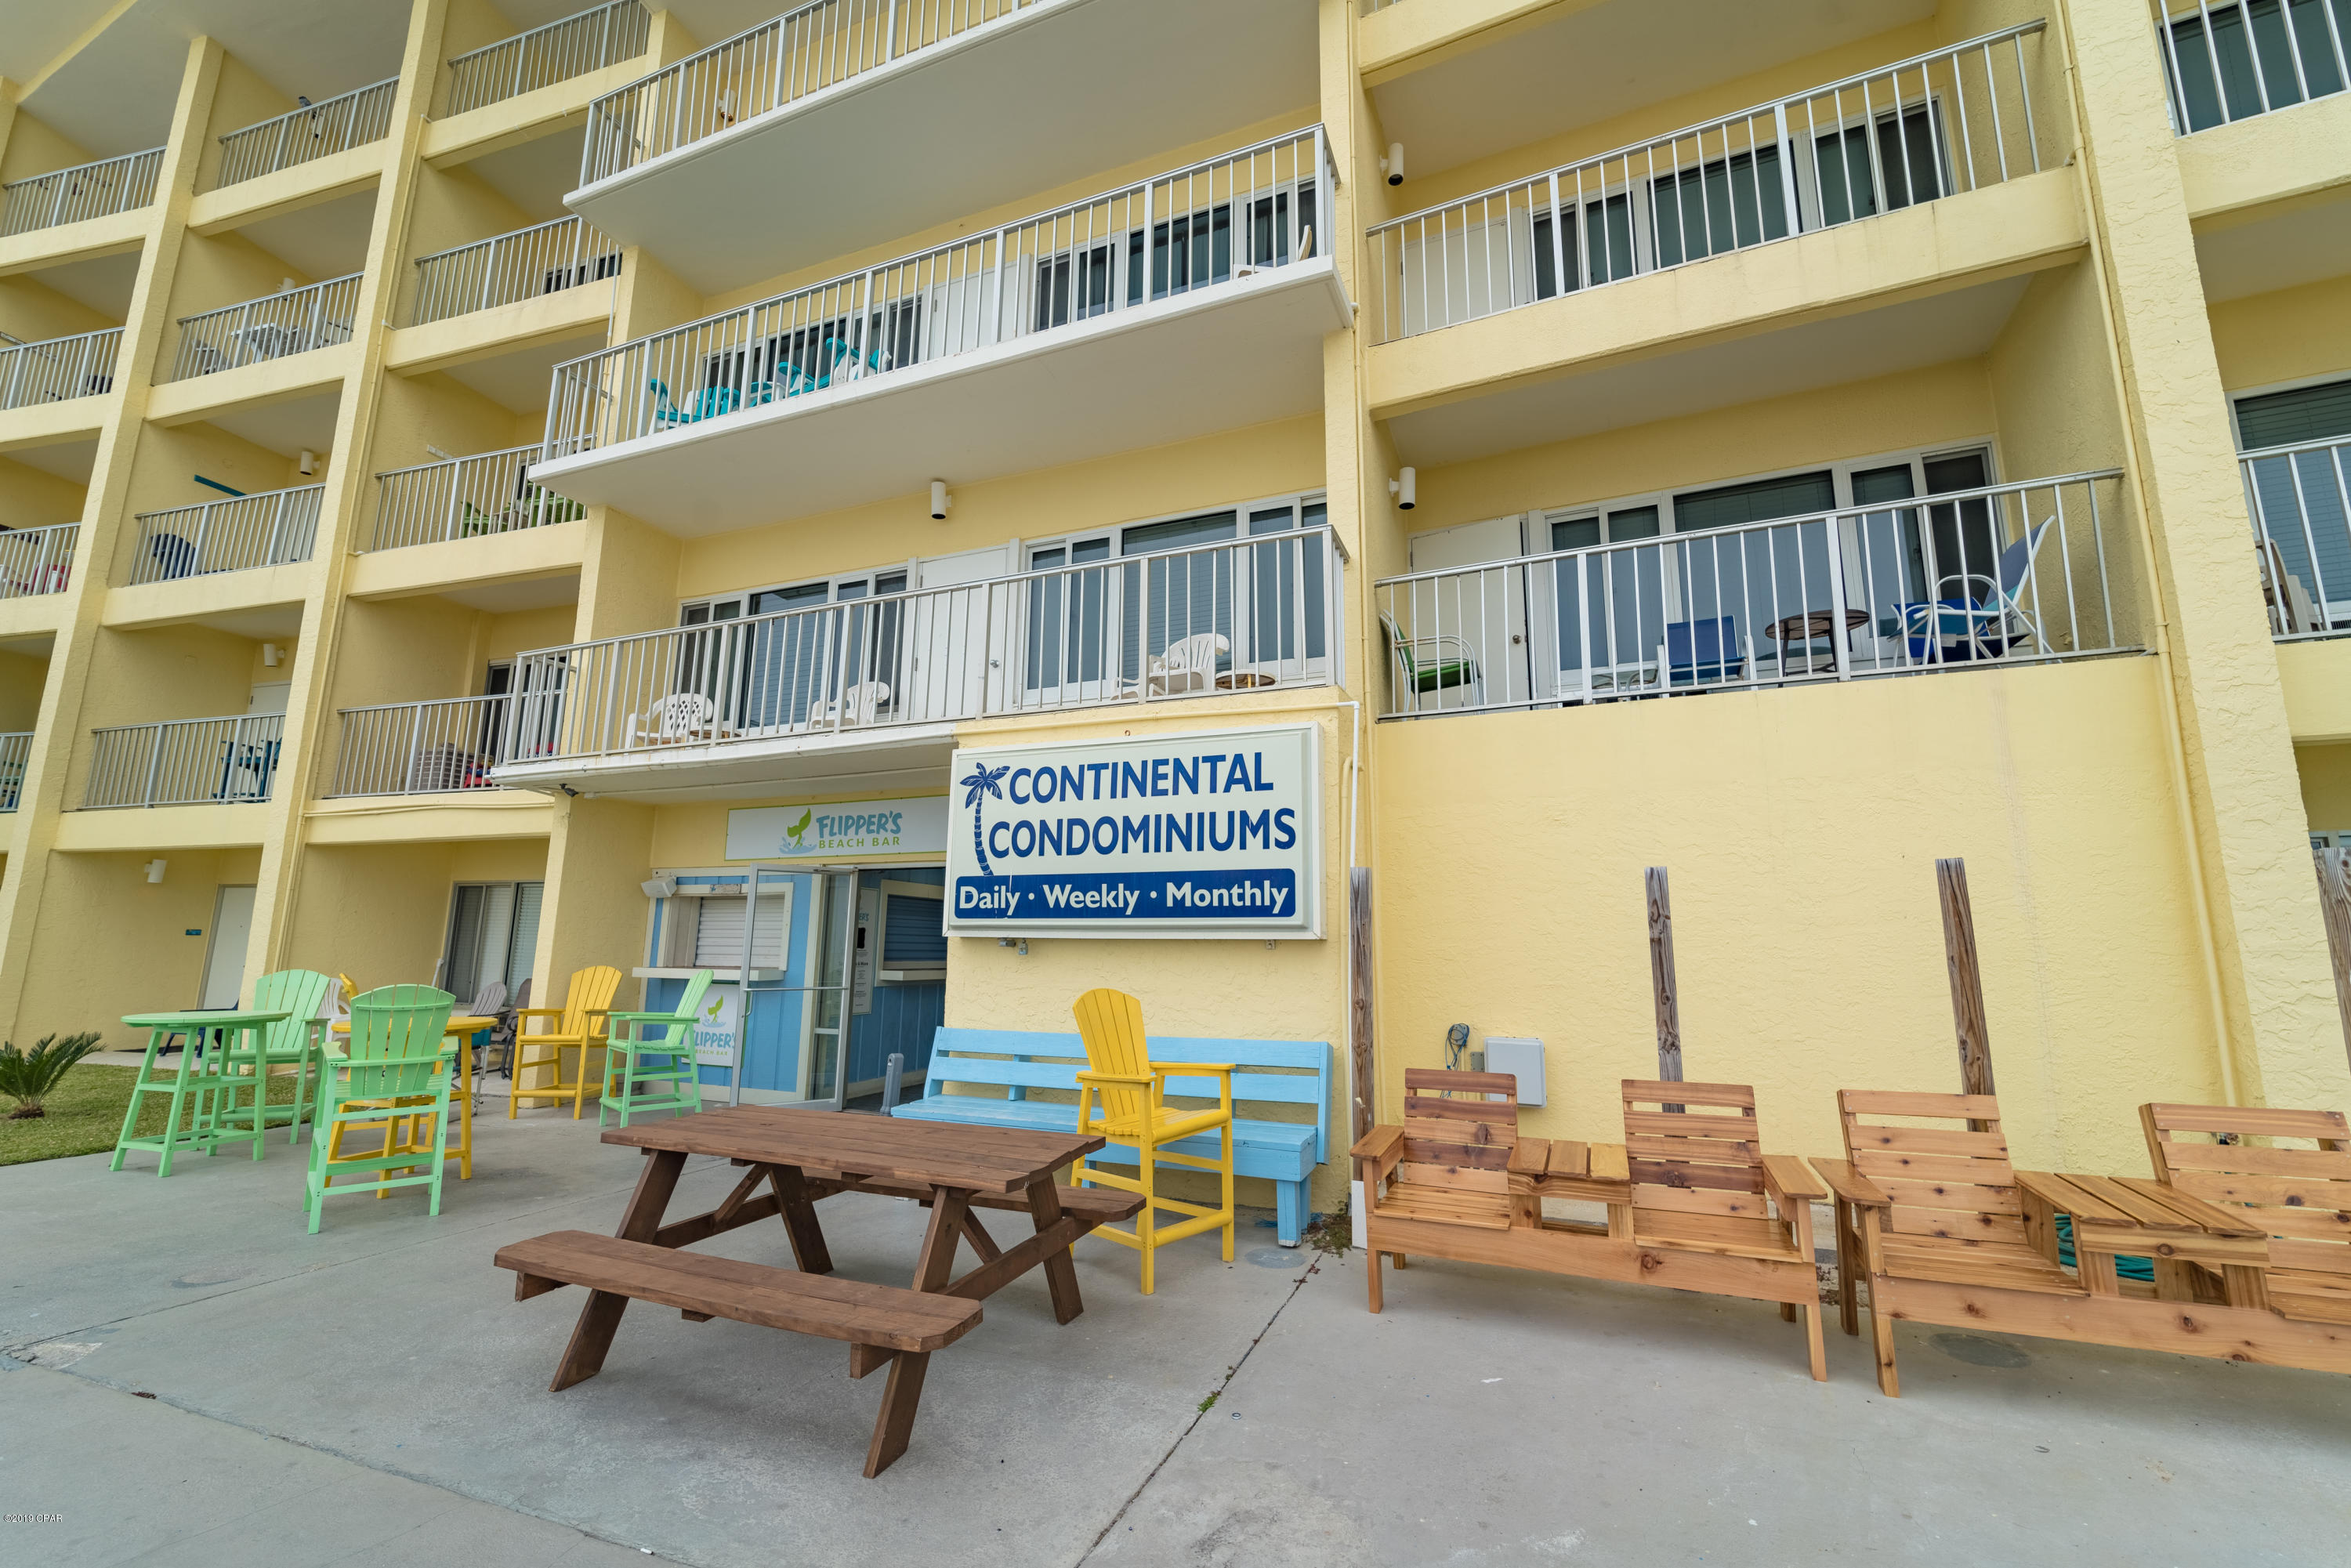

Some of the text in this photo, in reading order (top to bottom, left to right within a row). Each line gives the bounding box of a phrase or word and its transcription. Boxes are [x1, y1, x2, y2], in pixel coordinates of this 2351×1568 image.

[1009, 751, 1274, 805] CONTINENTAL
[816, 810, 903, 838] FLIPPER'S
[988, 807, 1297, 859] CONDOMINIUMS
[818, 835, 900, 849] BEACH BAR
[959, 880, 1289, 916] Daily Weekly Monthly
[694, 1030, 736, 1048] LIPPER'
